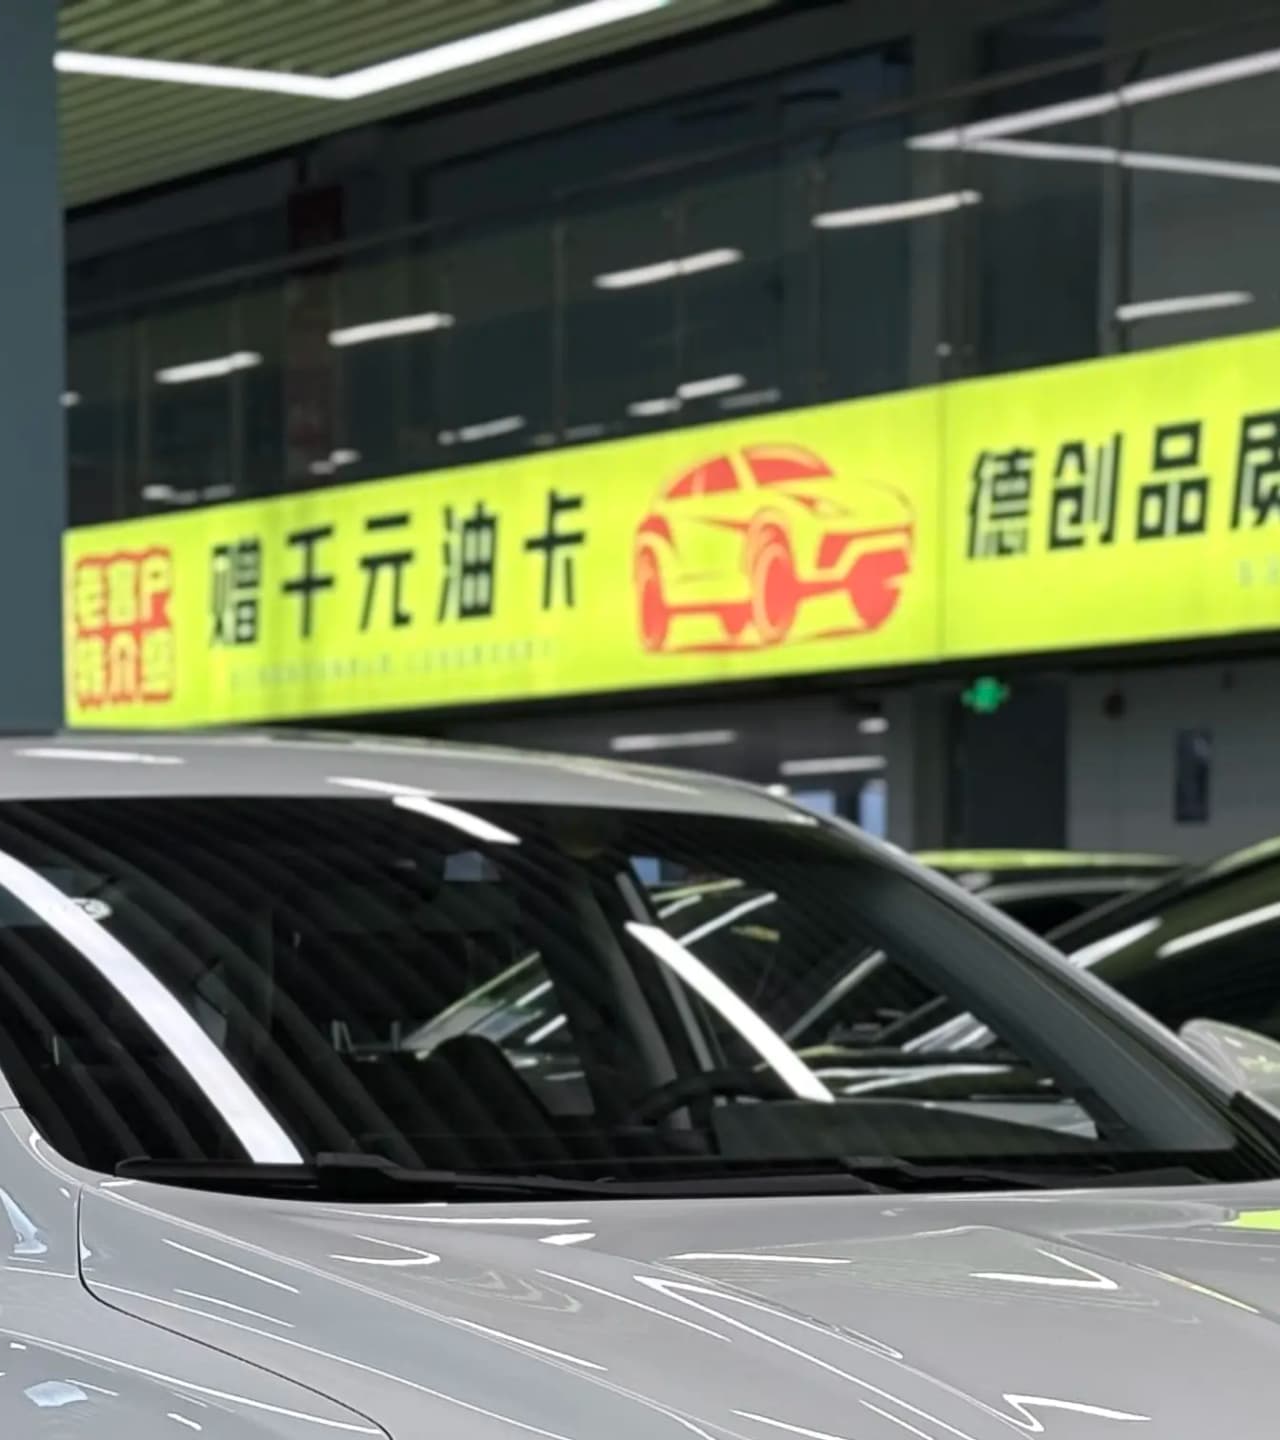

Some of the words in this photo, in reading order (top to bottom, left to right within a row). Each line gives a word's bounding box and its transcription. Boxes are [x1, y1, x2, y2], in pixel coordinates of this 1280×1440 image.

[210, 490, 587, 648] 赠千元油卡
